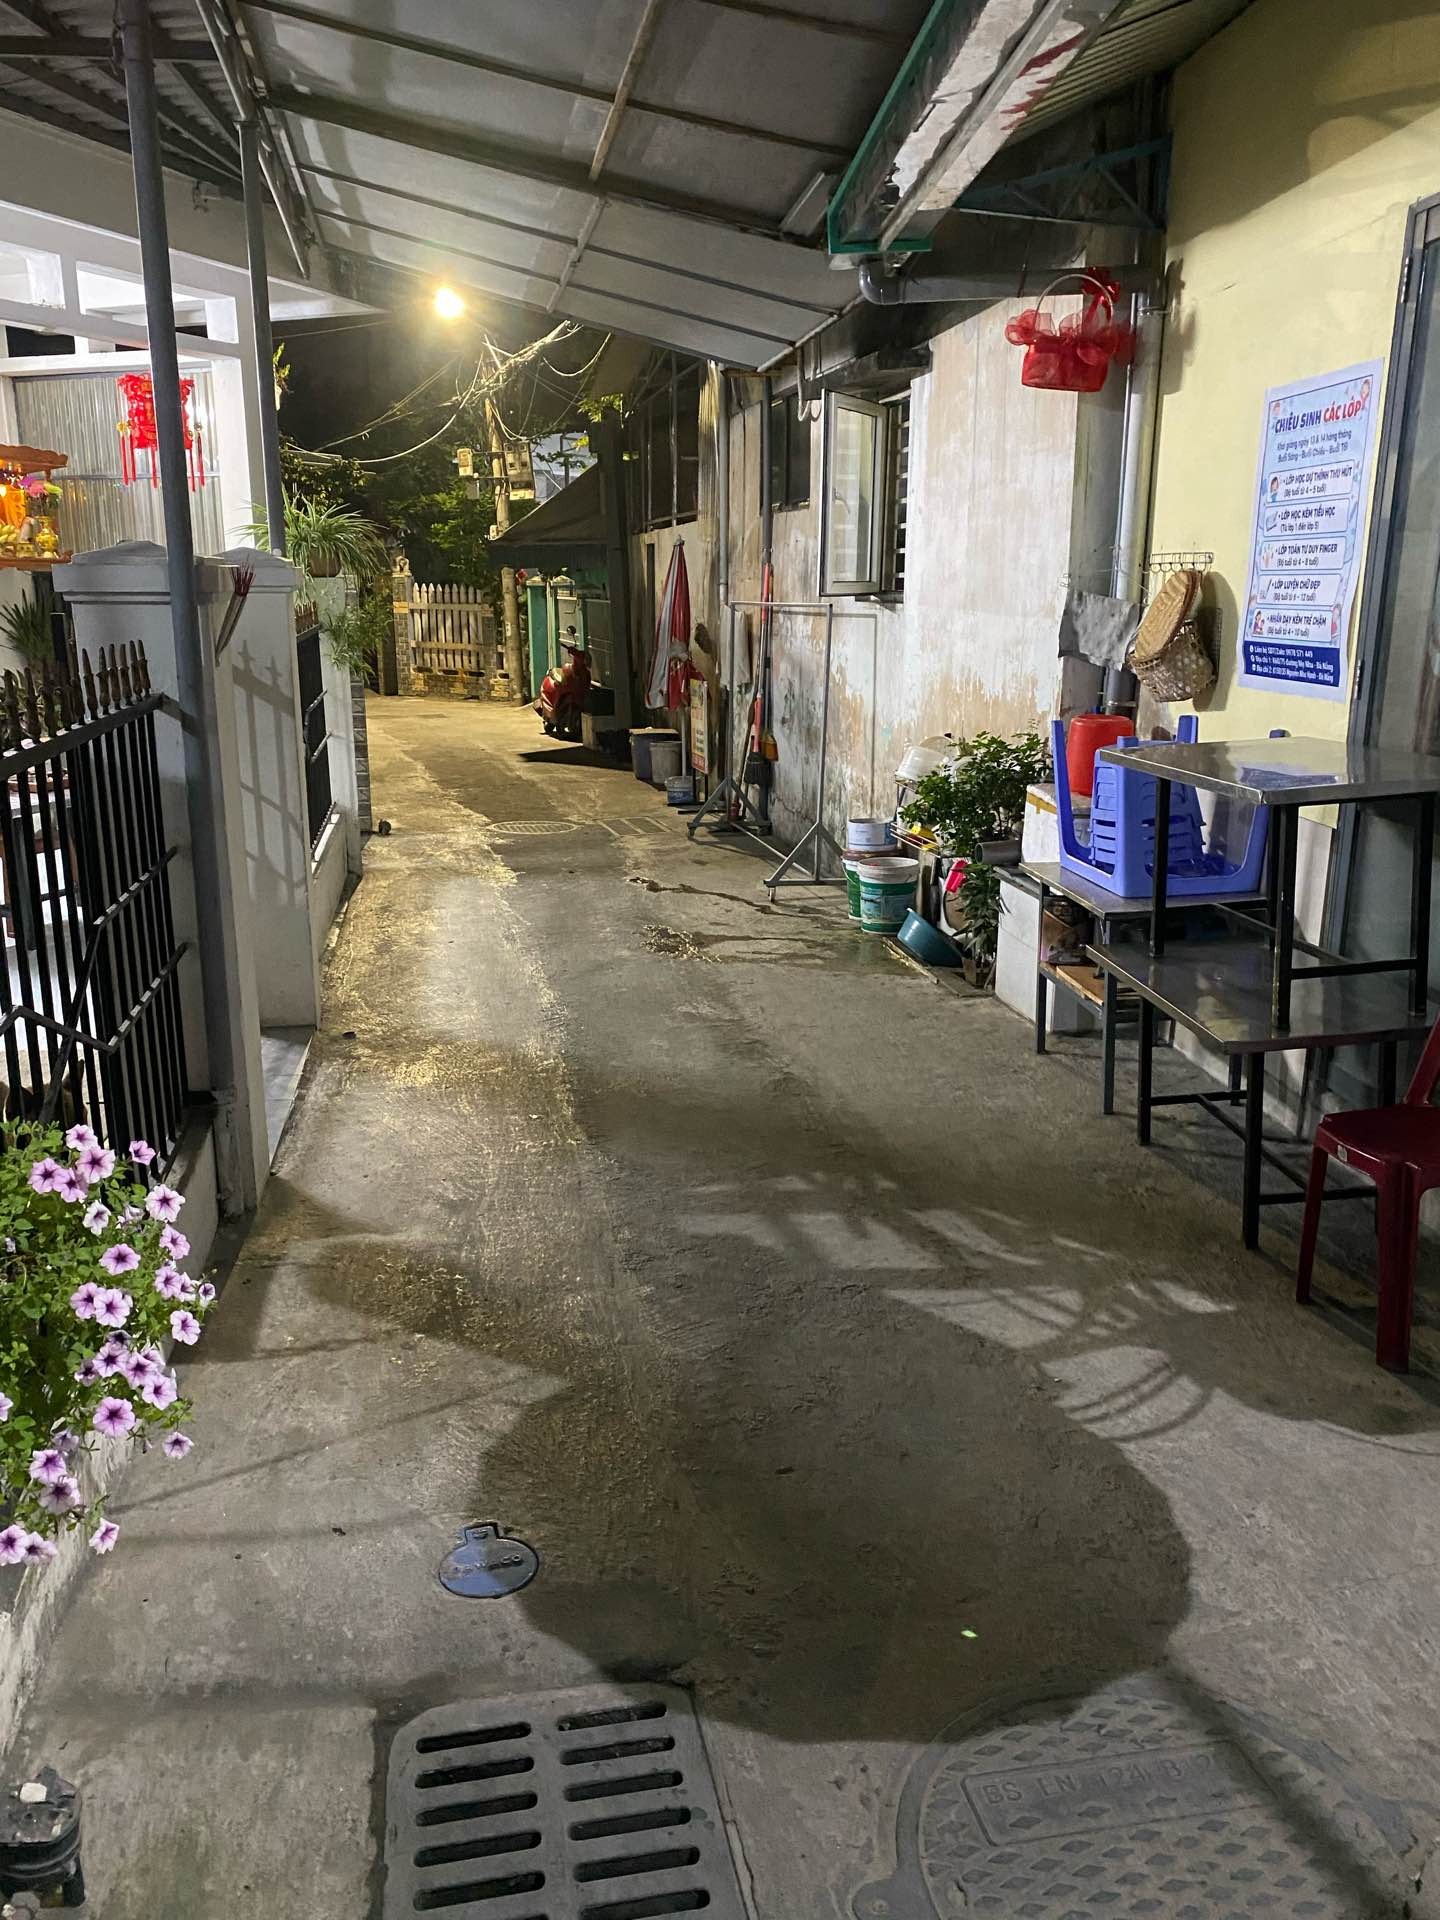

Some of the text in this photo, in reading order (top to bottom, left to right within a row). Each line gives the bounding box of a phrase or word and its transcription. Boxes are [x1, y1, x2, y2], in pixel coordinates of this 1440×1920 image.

[1275, 395, 1362, 433] CHIÊU SINH CÁC LỚP
[1286, 473, 1294, 485] LỚP
[1294, 474, 1304, 486] HỌC
[1329, 468, 1340, 478] THU
[1341, 464, 1352, 477] HÚT
[1281, 508, 1290, 520] LỚP
[1290, 510, 1301, 521] HỌC
[1314, 504, 1324, 517] TIỂU
[1324, 506, 1335, 518] HỌC
[1278, 543, 1287, 554] LỚP
[1287, 543, 1301, 554] TOÁN
[1308, 544, 1319, 553] DUY
[1319, 543, 1337, 553] FINGER
[1275, 578, 1283, 589] LỚP
[1283, 578, 1299, 591] LUYỆN
[1299, 578, 1310, 589] CHỮ
[1282, 615, 1291, 625] DẠY
[1312, 614, 1326, 628] CHẬM
[982, 1780, 1023, 1805] BS
[1038, 1773, 1078, 1797] EN
